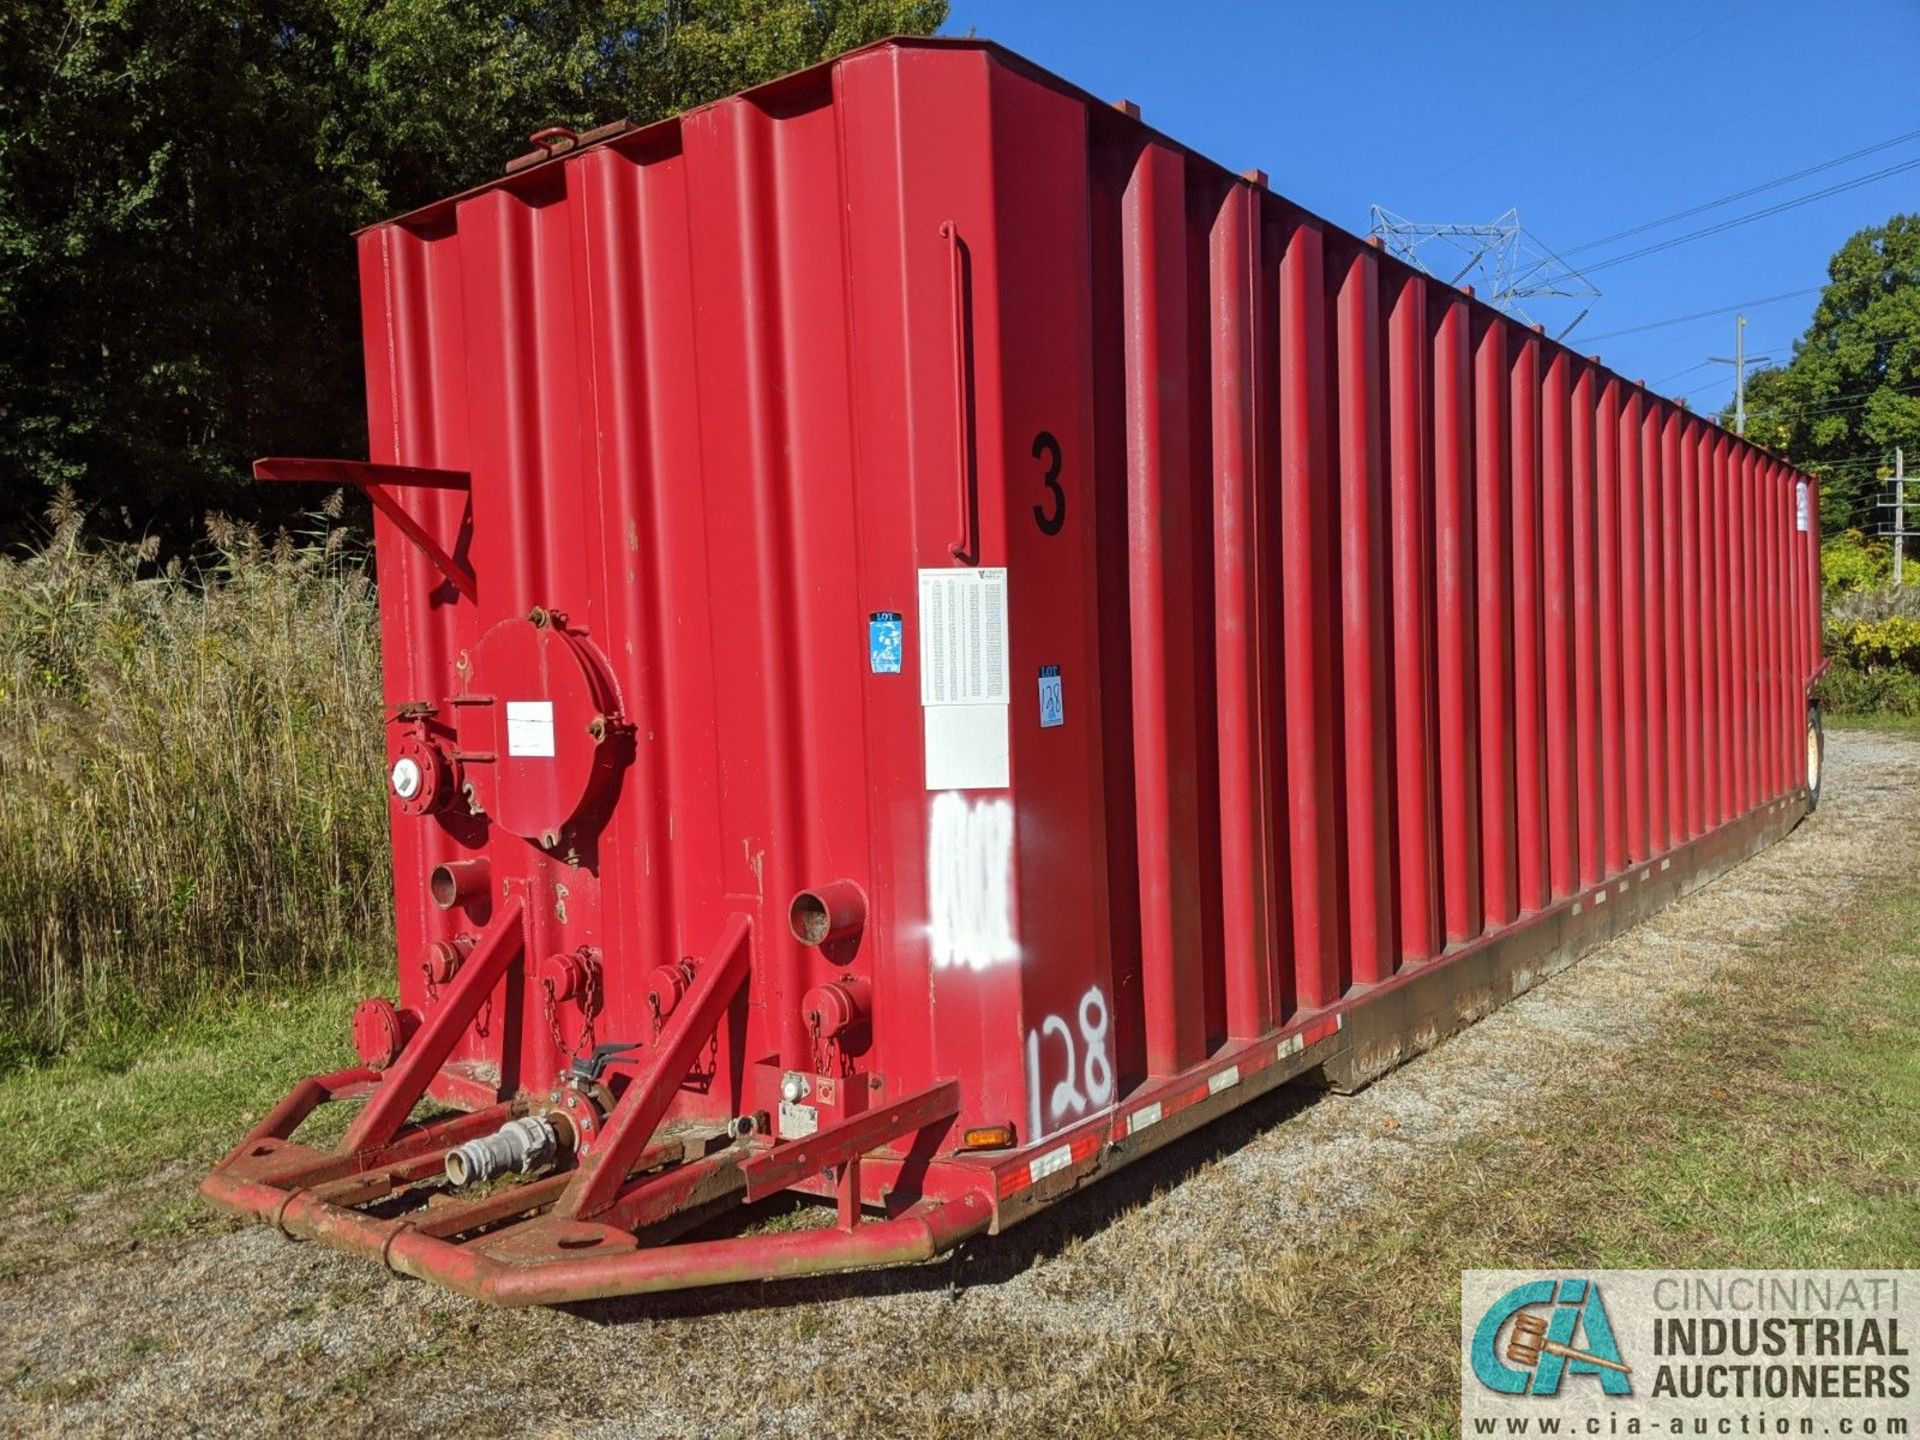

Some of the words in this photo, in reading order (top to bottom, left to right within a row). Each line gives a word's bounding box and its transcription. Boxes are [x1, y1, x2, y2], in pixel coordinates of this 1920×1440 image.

[1031, 431, 1065, 535] 3
[876, 612, 894, 621] LOT
[1041, 683, 1061, 713] 128
[1027, 985, 1112, 1142] 128
